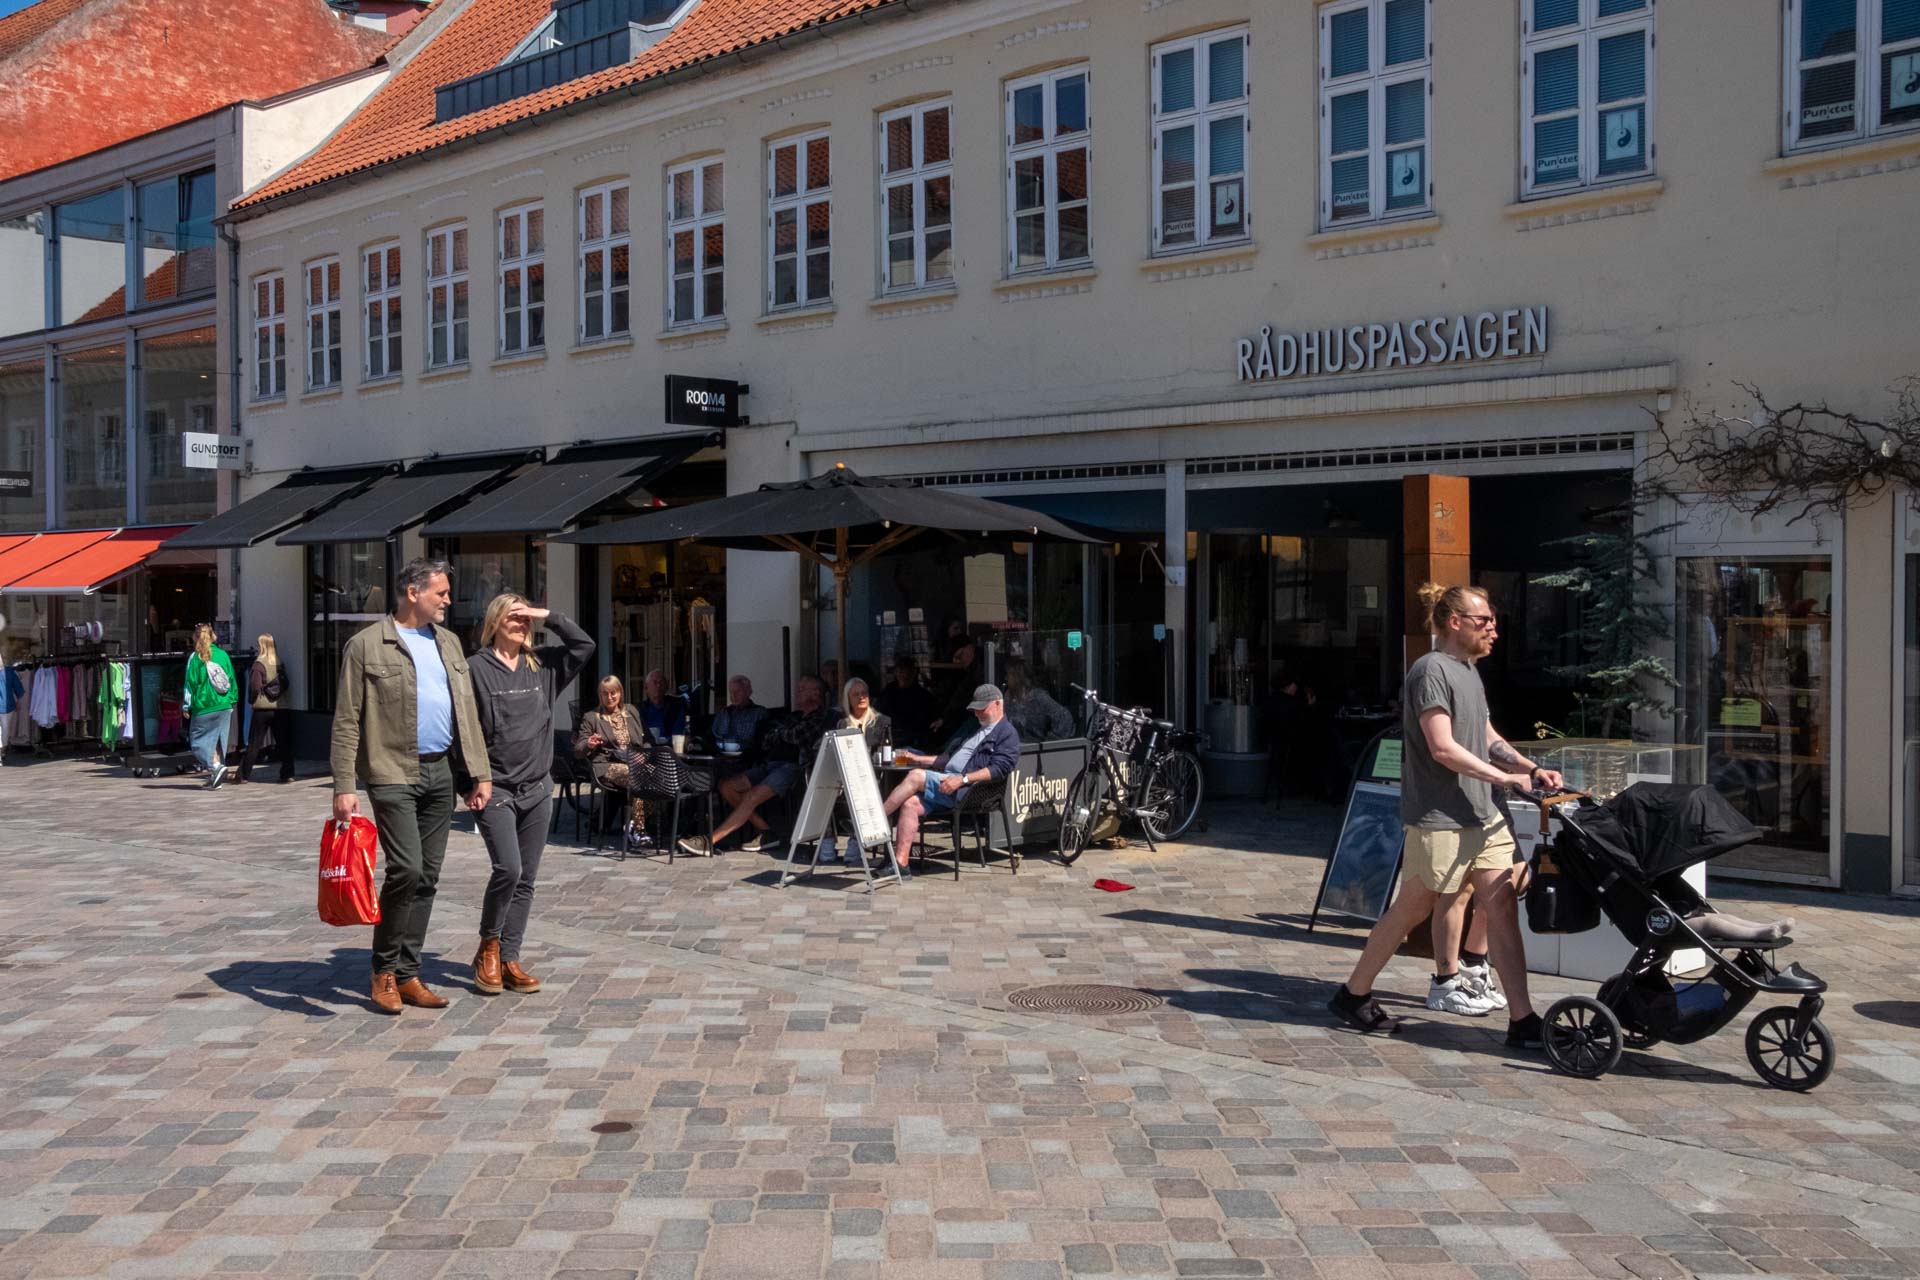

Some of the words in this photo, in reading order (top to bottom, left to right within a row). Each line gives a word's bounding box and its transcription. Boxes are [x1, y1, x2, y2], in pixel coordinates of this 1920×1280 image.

[1237, 305, 1548, 381] RÅDHUSPASSAGEN
[686, 390, 726, 407] ROOM4
[191, 443, 240, 455] GUNDTOFT
